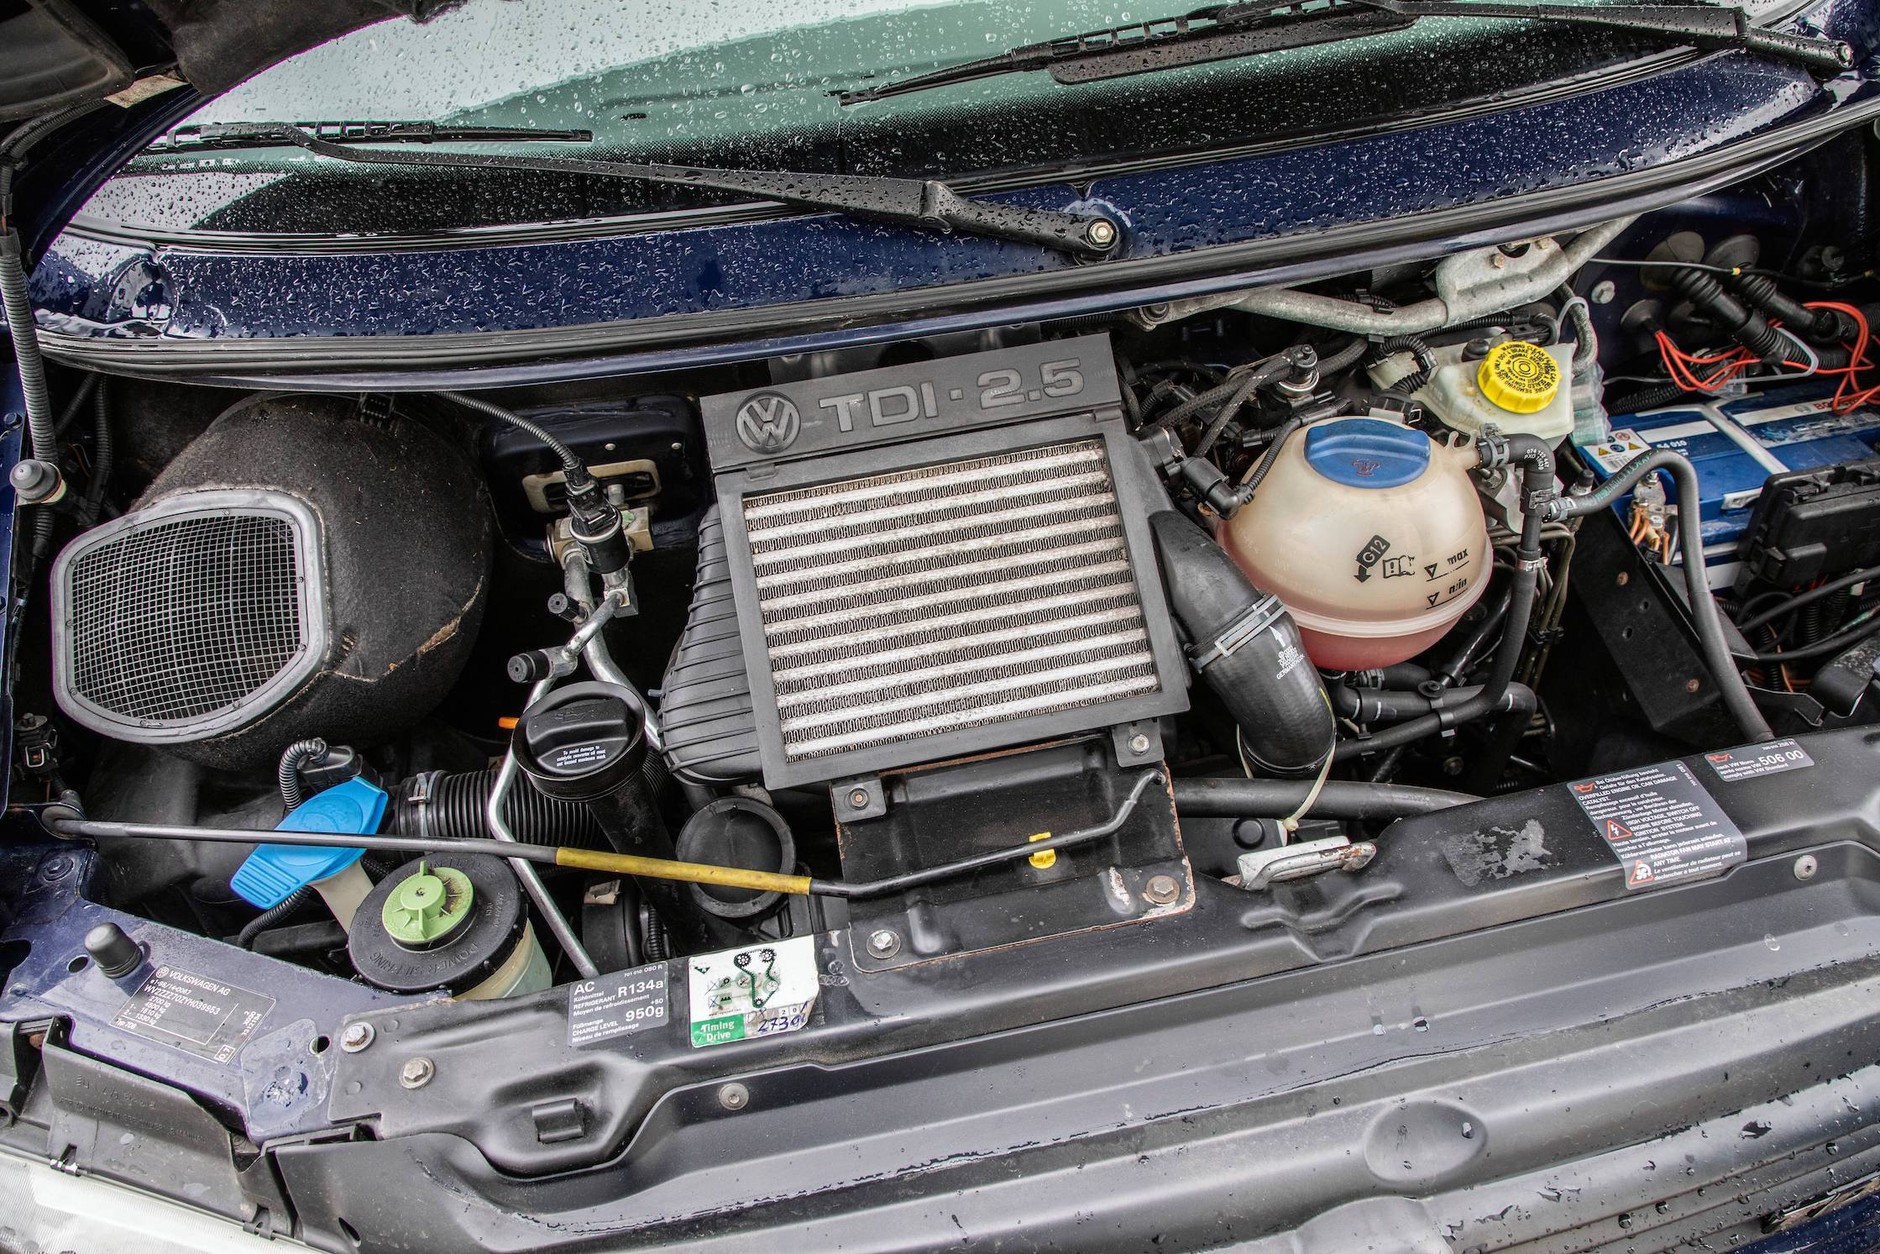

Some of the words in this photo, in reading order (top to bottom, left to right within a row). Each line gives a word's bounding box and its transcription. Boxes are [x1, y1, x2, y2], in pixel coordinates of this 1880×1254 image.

[1527, 345, 1544, 357] CLEAN
[818, 381, 939, 433] TDI
[976, 358, 1084, 410] 2.5
[1362, 538, 1387, 563] G12
[1447, 549, 1468, 566] max
[1449, 578, 1467, 595] min
[1758, 753, 1785, 766] 506
[1785, 750, 1803, 760] 00
[1579, 790, 1611, 800] OVERFILLED
[1611, 786, 1631, 794] ENGINE
[1654, 775, 1677, 785] DAMAGE
[1629, 823, 1651, 832] ENGINE
[1651, 819, 1673, 827] BEFORE
[1673, 811, 1702, 822] TOUCHING
[1666, 809, 1690, 817] SWITCH
[1634, 828, 1660, 837] IGNITION
[1650, 849, 1679, 860] RADIATOR
[1680, 846, 1691, 854] FAN
[1691, 843, 1705, 851] MAY
[1705, 839, 1724, 848] START
[1698, 855, 1721, 864] radiateur
[169, 970, 219, 992] VOLKSWAGEN
[219, 987, 231, 996] AG
[574, 981, 595, 996] AC
[617, 979, 664, 998] R134a
[573, 995, 616, 1010] REFRIGERANT
[573, 1008, 593, 1017] Moyen
[603, 995, 649, 1009] refroidissement
[625, 1005, 664, 1022] 950g
[572, 1025, 600, 1036] CHARGE
[599, 1021, 618, 1030] LEVEL
[572, 1034, 593, 1043] Niveau
[603, 1023, 639, 1036] remplissage
[701, 1020, 734, 1033] Timing
[706, 1030, 731, 1042] Drive
